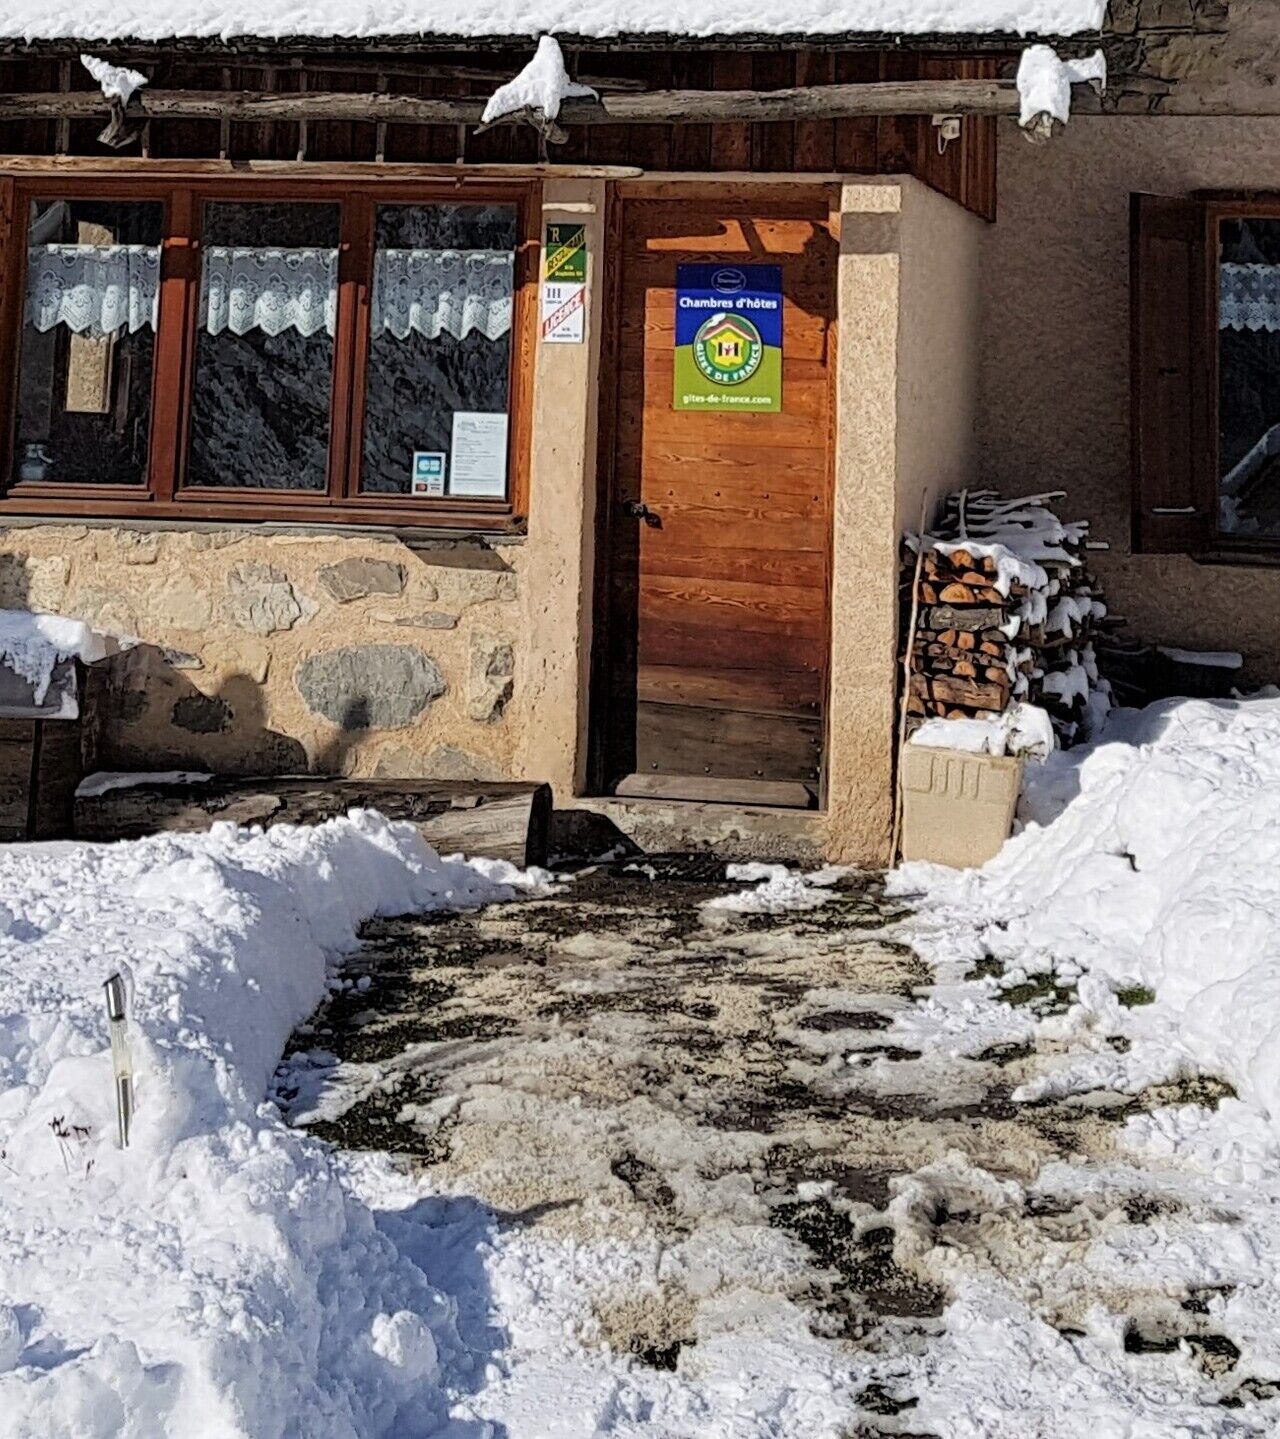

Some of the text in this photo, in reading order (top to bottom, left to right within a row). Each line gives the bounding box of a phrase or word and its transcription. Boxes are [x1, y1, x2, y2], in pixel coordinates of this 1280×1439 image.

[679, 296, 778, 309] Chambres d'hôtes
[714, 371, 729, 382] DE
[732, 343, 760, 381] FRANCE
